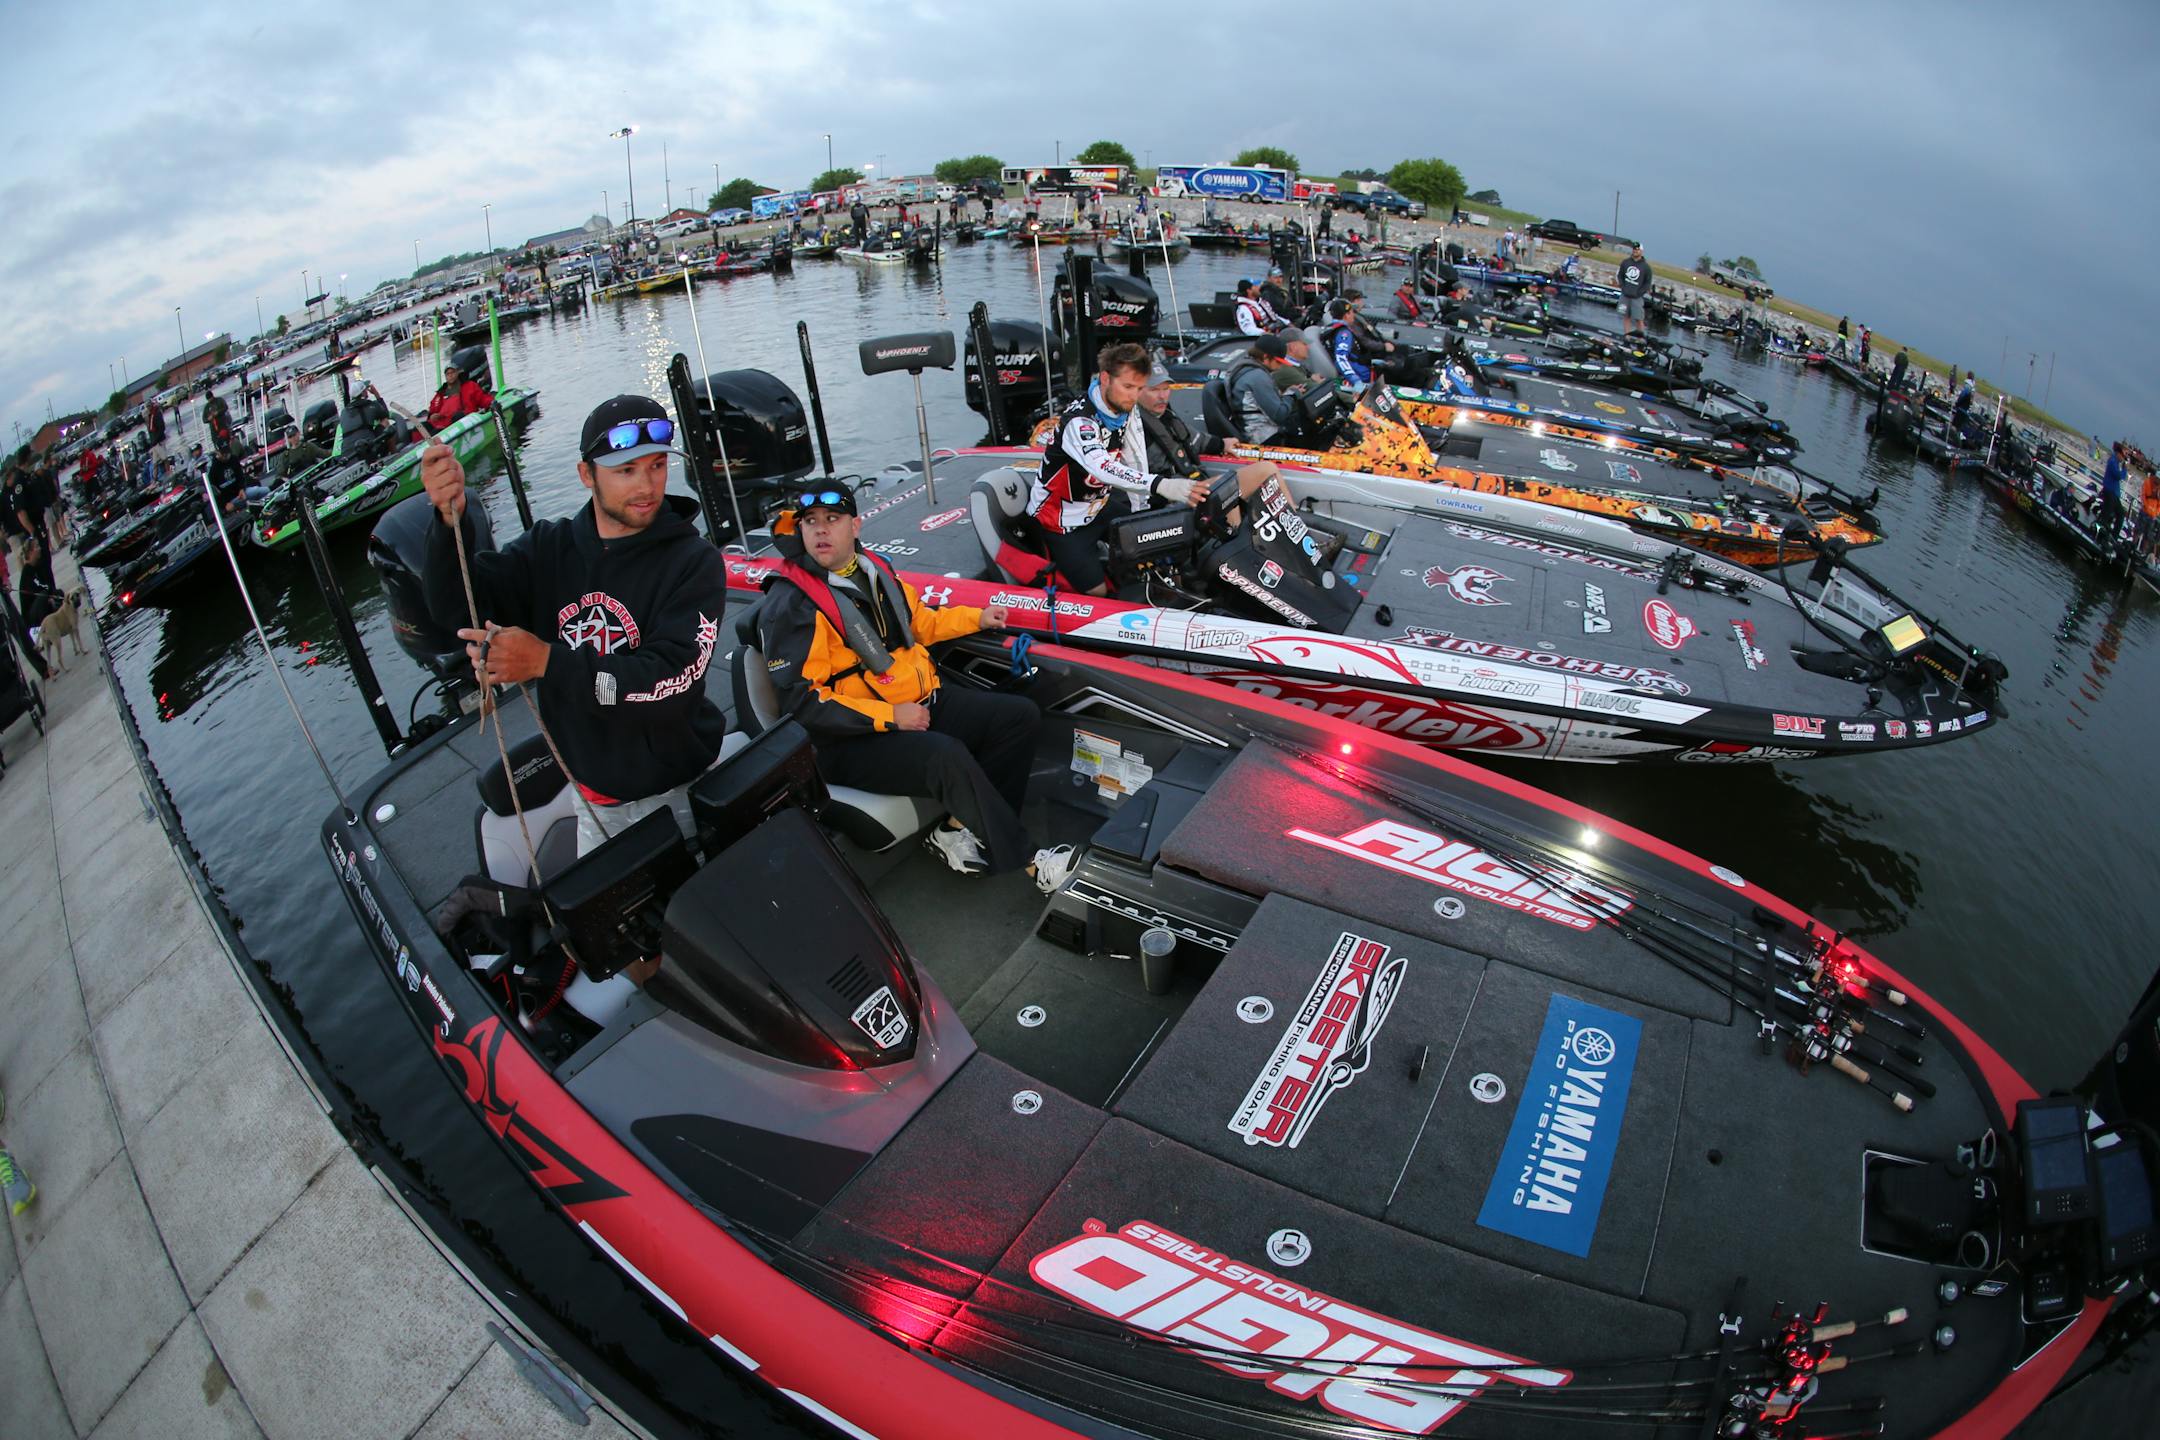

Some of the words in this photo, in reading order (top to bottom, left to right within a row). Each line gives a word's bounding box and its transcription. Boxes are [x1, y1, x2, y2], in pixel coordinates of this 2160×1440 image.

[1069, 169, 1106, 178] Triton
[1212, 174, 1248, 185] YAMAHA
[1263, 452, 1321, 463] SHRYOCK
[1436, 498, 1484, 513] LOWRANCE
[1137, 526, 1184, 544] LOWRANCE
[1253, 510, 1283, 542] 15
[860, 541, 920, 556] COSTA
[1631, 540, 1661, 553] Trilene
[1709, 562, 1768, 590] PHOENIX
[989, 591, 1040, 610] JUSTIN
[1040, 596, 1094, 618] LUCAS
[1235, 576, 1318, 629] PHOENIX
[1118, 630, 1147, 642] COSTA
[1652, 603, 1676, 645] Berkley
[1189, 629, 1245, 649] Trilene
[1402, 632, 1639, 685] PHOENIX
[1459, 672, 1543, 697] PowerBait
[1580, 691, 1641, 714] HAVOC
[1772, 713, 1827, 735] BOLT
[1841, 733, 1874, 742] TUNGSTEN
[513, 758, 554, 785] SKEETER
[1290, 819, 1635, 921] RIGID
[1454, 880, 1593, 929] INDUSTRIES
[1297, 936, 1356, 1025] PERFORMANCE
[855, 989, 885, 1019] SKEETER
[866, 997, 894, 1036] FX
[881, 1020, 904, 1045] 20
[1253, 939, 1385, 1144] SKEETER
[1555, 1019, 1576, 1069] PRO
[1269, 1026, 1303, 1078] FISHING
[1238, 1080, 1271, 1128] BOATS
[1513, 1084, 1557, 1206] FISHING
[1526, 1067, 1608, 1215] YAMAHA
[1126, 1224, 1324, 1312] INDUSTRIES
[1034, 1236, 1569, 1435] RIGID
